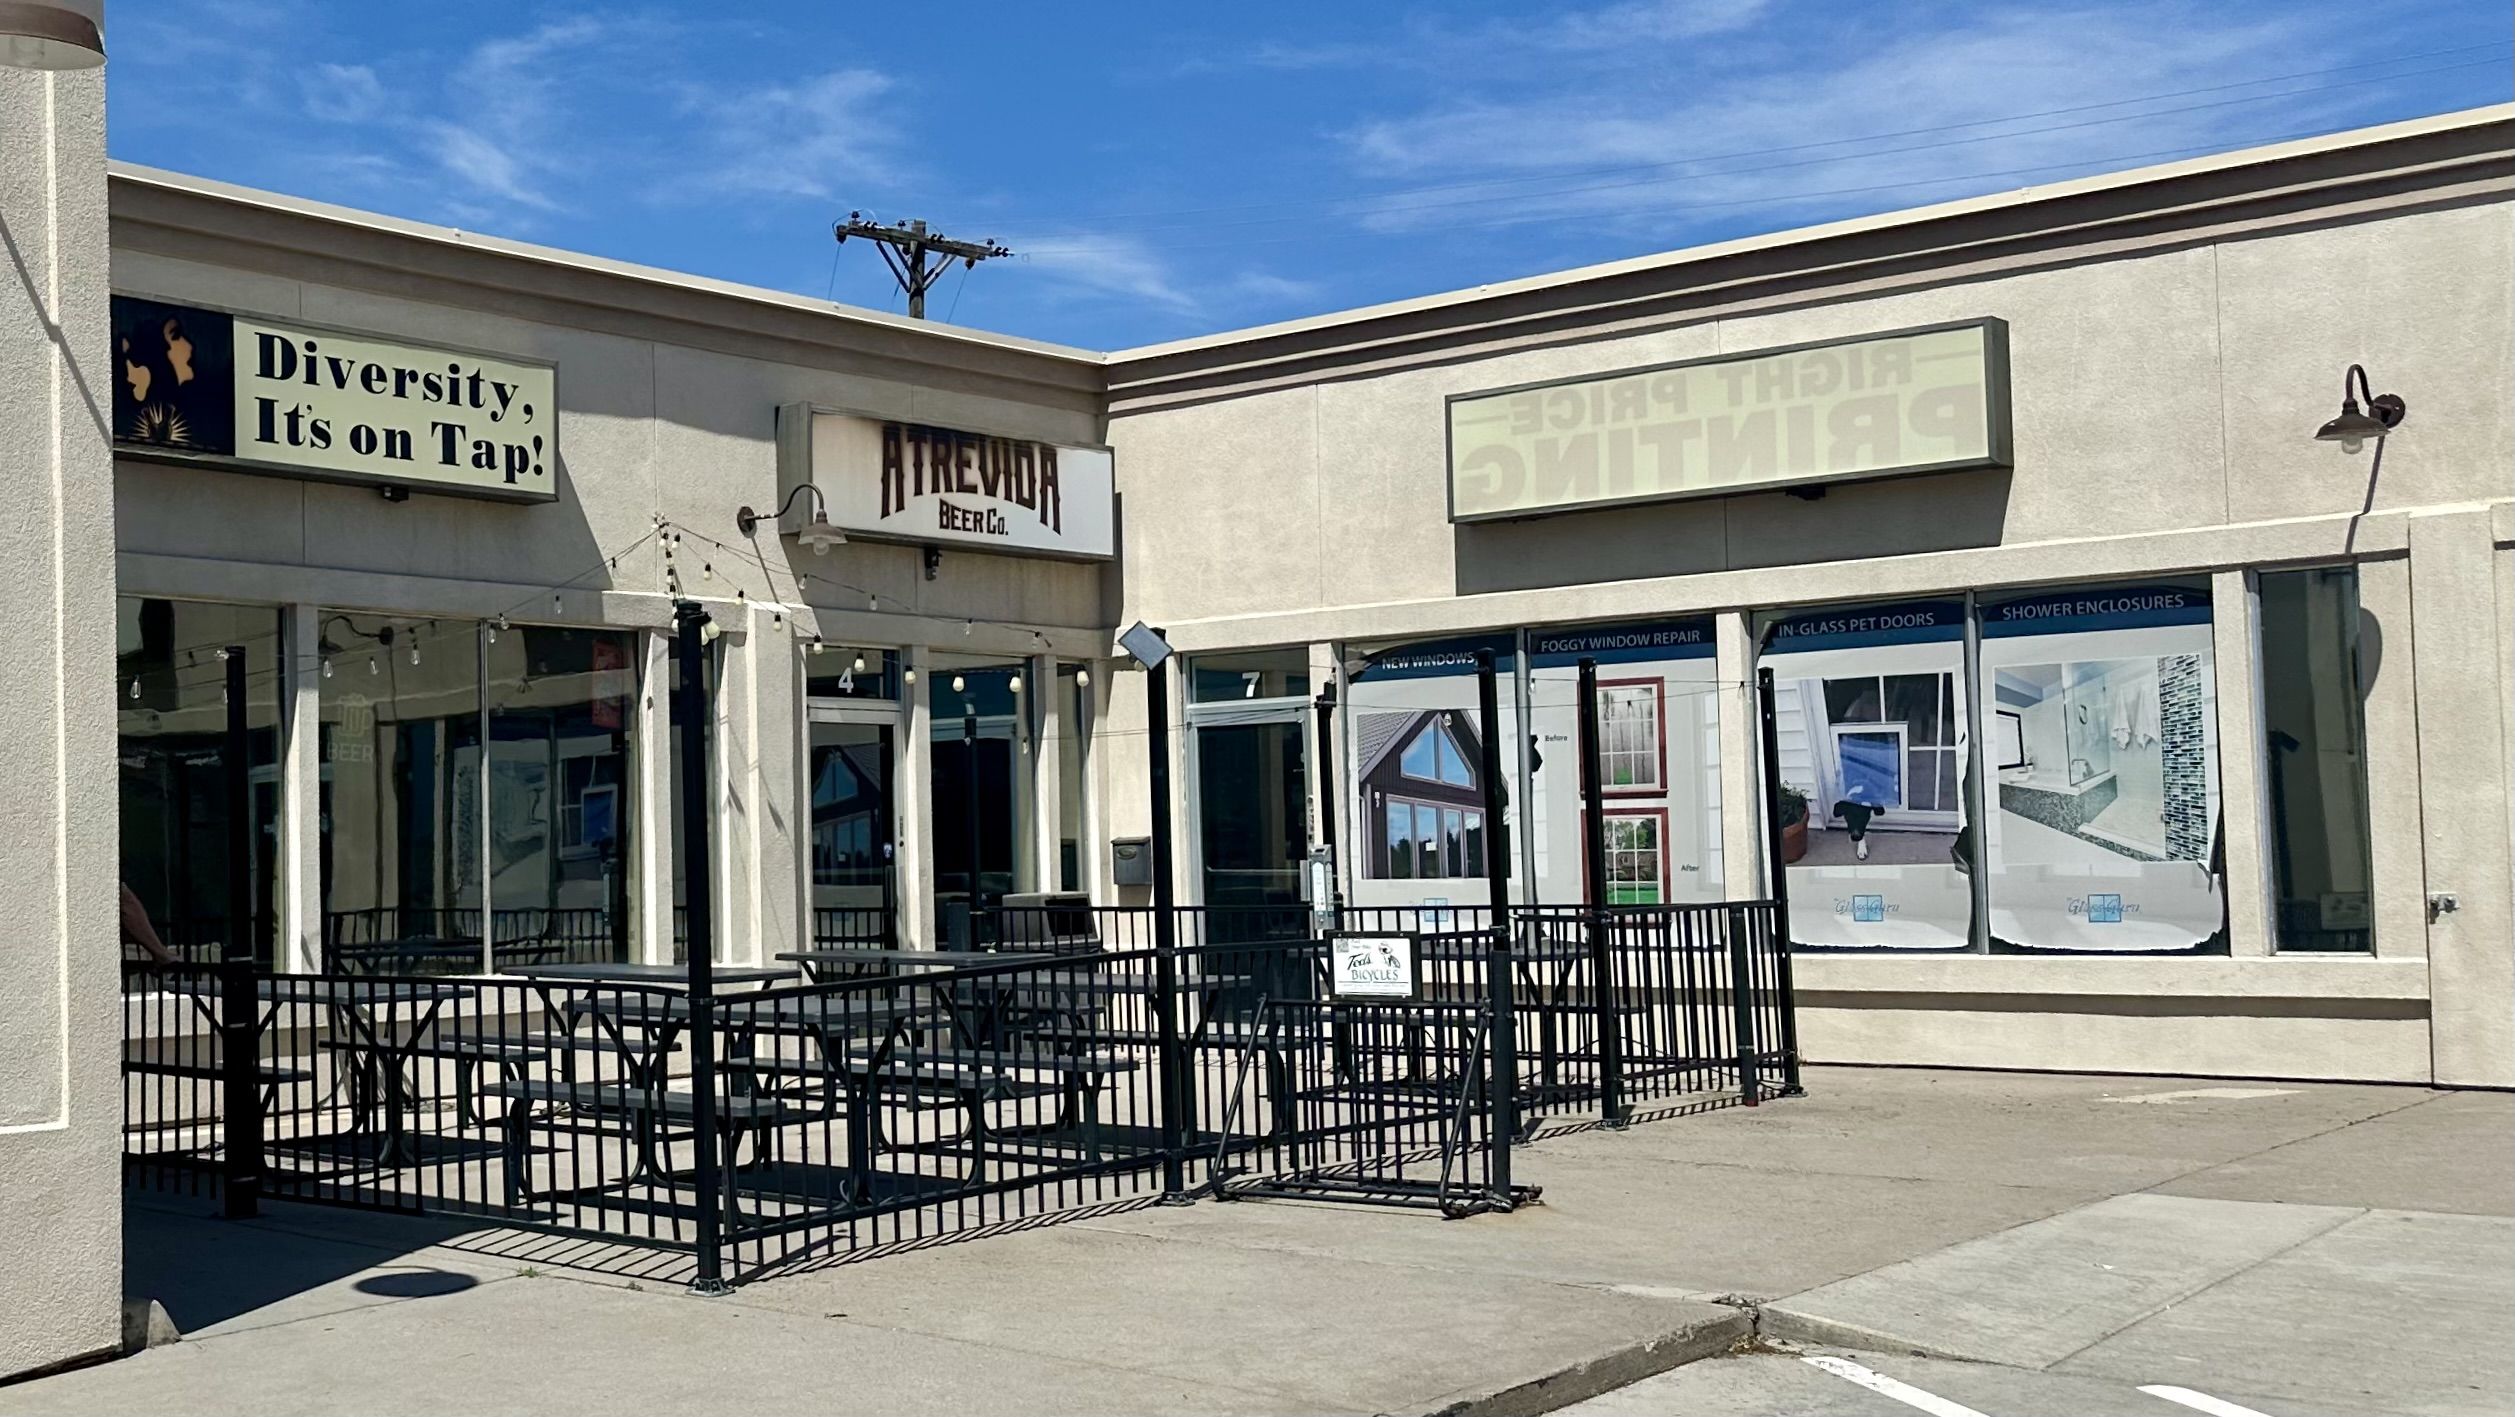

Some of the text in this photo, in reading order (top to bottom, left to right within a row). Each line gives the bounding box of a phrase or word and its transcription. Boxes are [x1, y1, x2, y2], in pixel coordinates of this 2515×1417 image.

[254, 331, 534, 425] Diversity,
[254, 396, 544, 485] It's on Tap!
[880, 422, 1061, 536] ATREVIDA
[939, 498, 984, 534] BEER
[2002, 594, 2184, 621] SHOWER ENCLOSURES
[1779, 613, 1934, 637] IN-GLASS PET DOORS
[1541, 630, 1700, 652] FOGGY WINDOW REPAIR
[1382, 651, 1475, 670] NEW WINDOWS
[838, 667, 854, 693] 4
[1242, 671, 1260, 698] 7
[1545, 734, 1568, 742] Before
[327, 743, 375, 763] BEER
[1681, 864, 1700, 872] After
[1351, 969, 1399, 982] BICYCLES
